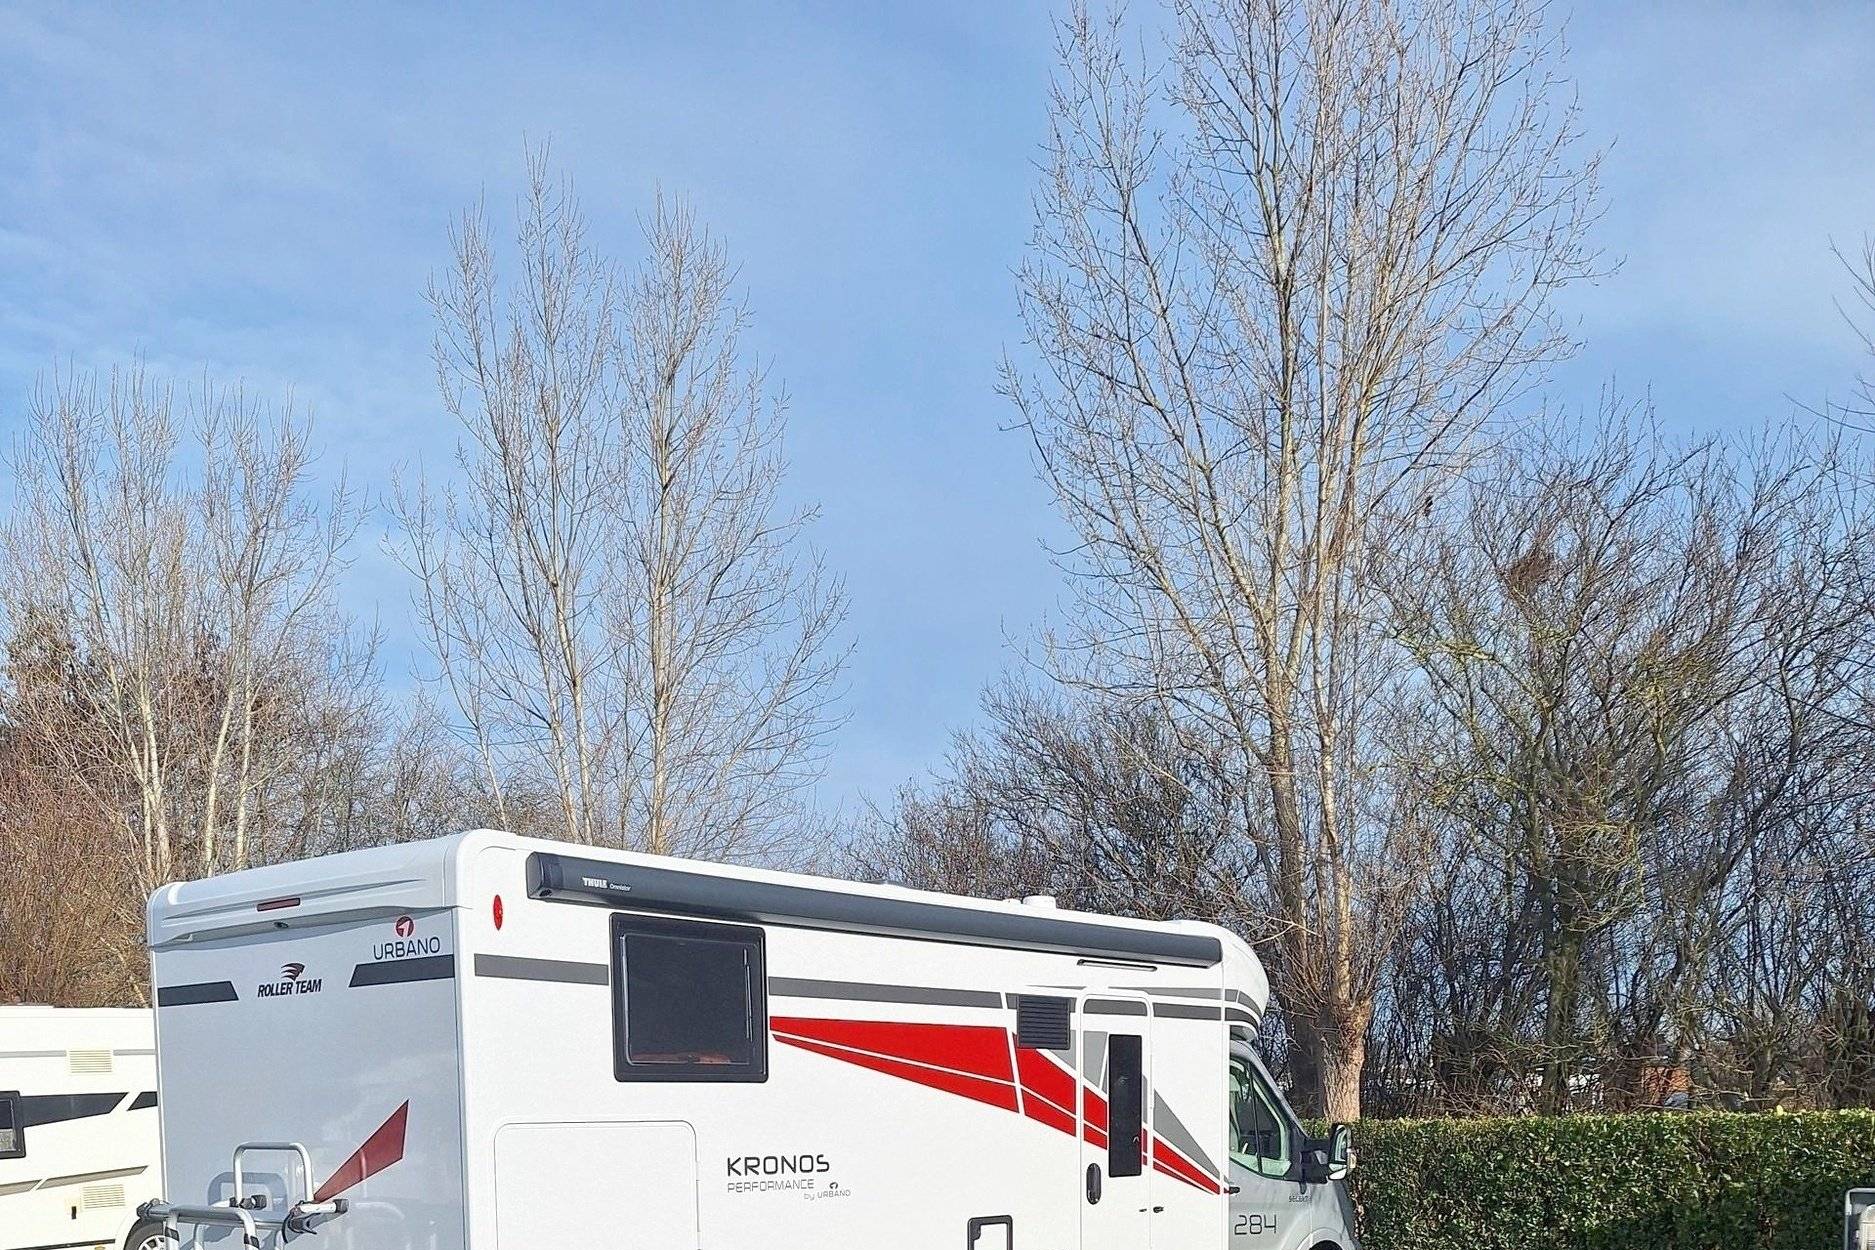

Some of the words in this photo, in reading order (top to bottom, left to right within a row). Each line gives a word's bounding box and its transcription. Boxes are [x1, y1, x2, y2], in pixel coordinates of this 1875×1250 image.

[582, 877, 608, 889] THULE
[373, 936, 441, 961] URBANO
[258, 981, 293, 998] ROLLER
[295, 979, 322, 995] TEAM
[727, 1154, 830, 1176] KRONOS
[727, 1179, 815, 1193] PERFORMANCE
[804, 1193, 815, 1201] by
[817, 1189, 852, 1199] URBANO
[1234, 1214, 1277, 1236] 284
